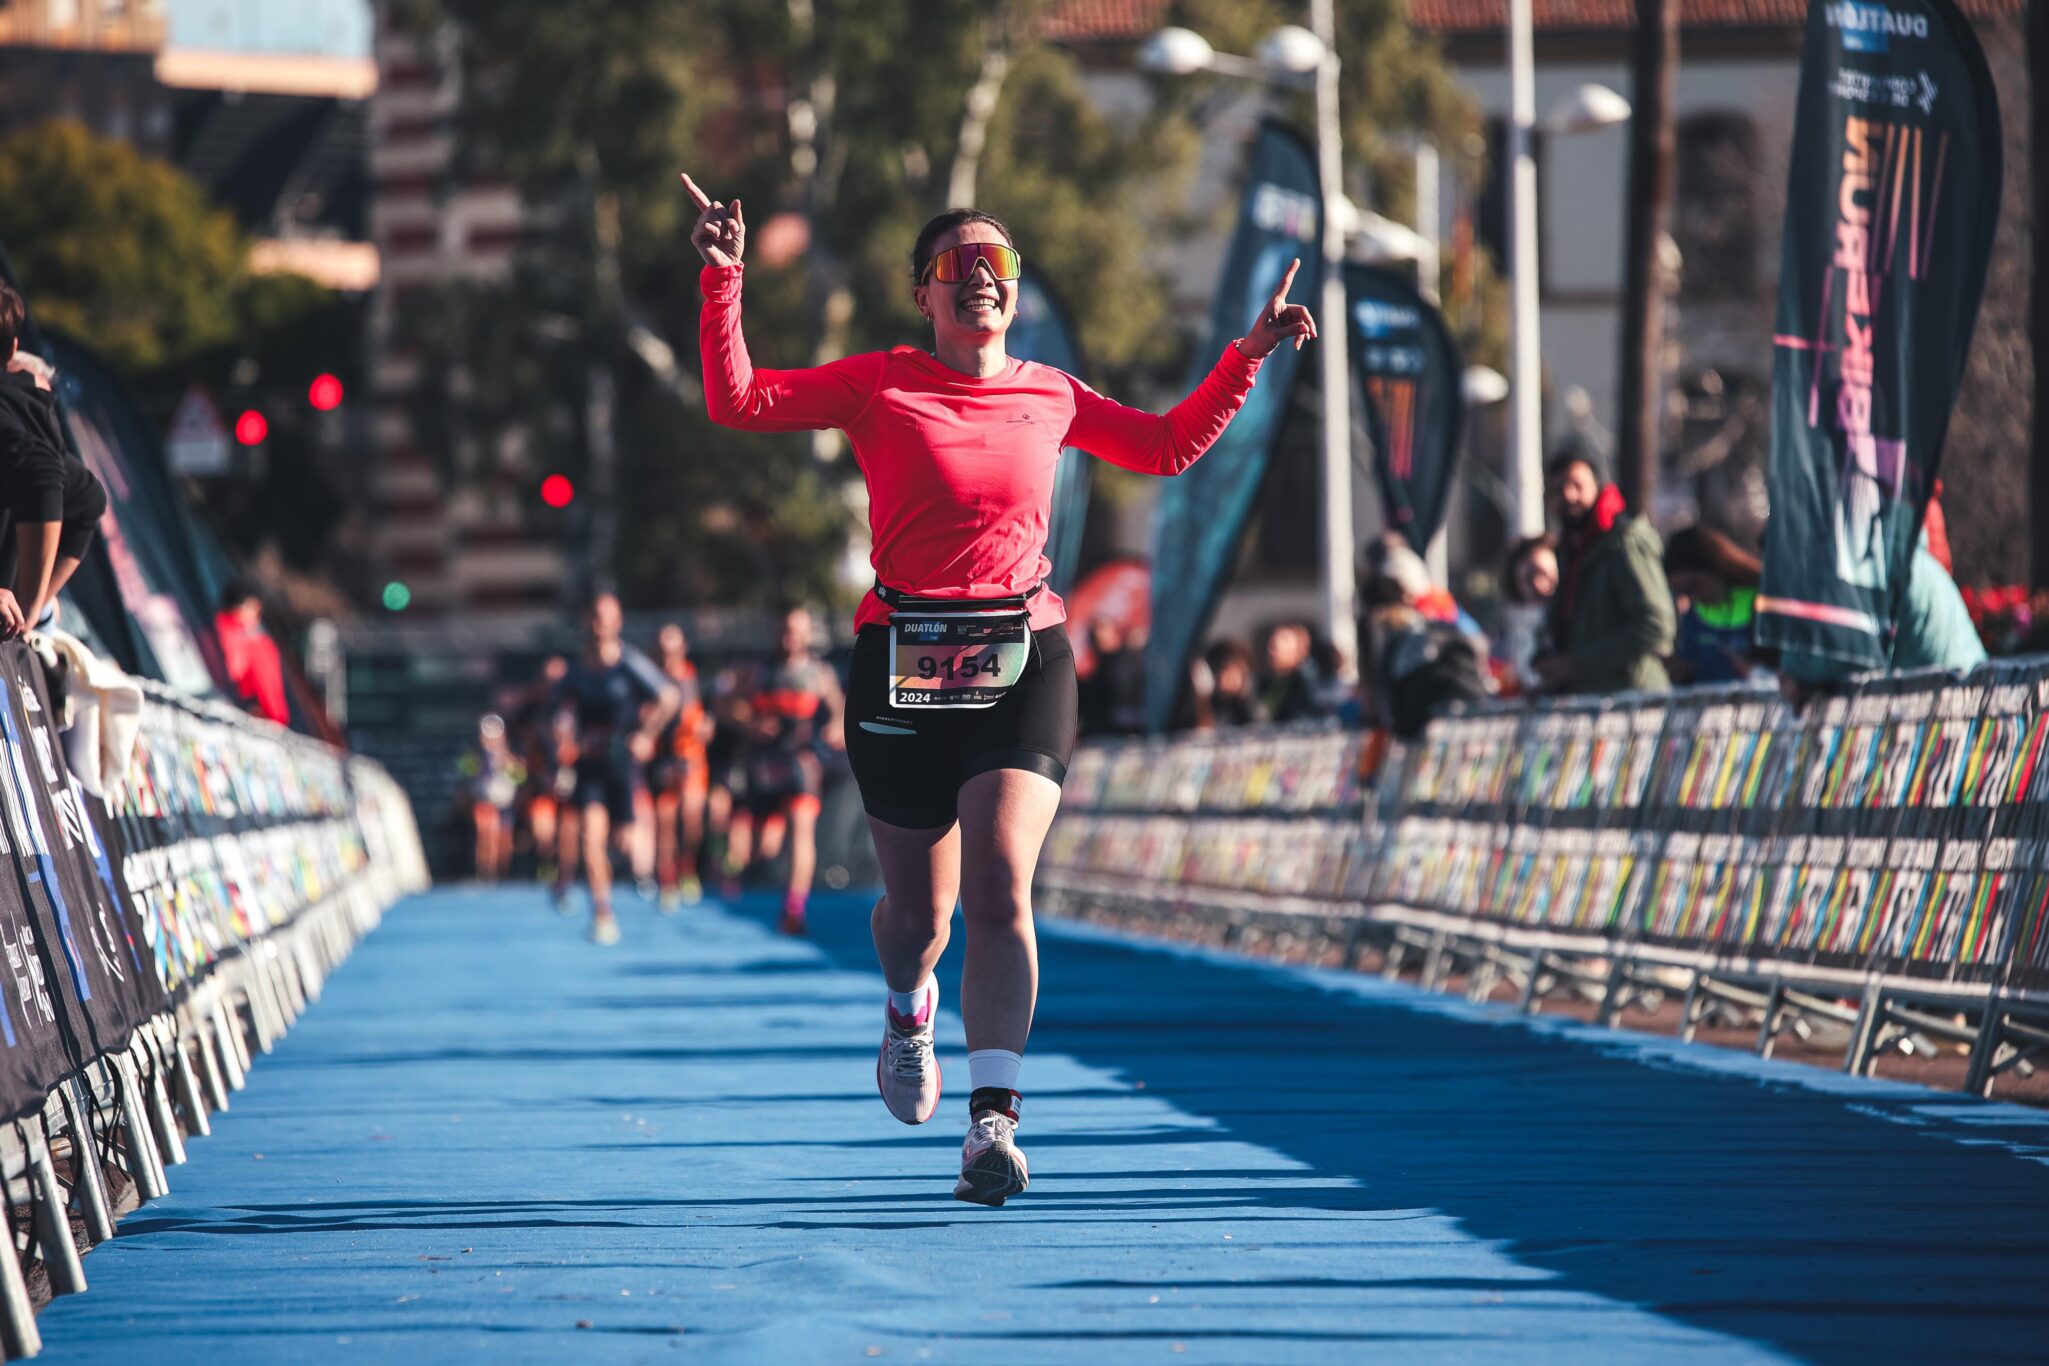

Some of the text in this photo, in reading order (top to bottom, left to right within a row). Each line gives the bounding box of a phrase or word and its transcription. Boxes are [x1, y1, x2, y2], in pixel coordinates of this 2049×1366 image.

[904, 621, 947, 633] DUATLÓN
[917, 653, 1001, 681] 9154
[900, 692, 930, 703] 2024
